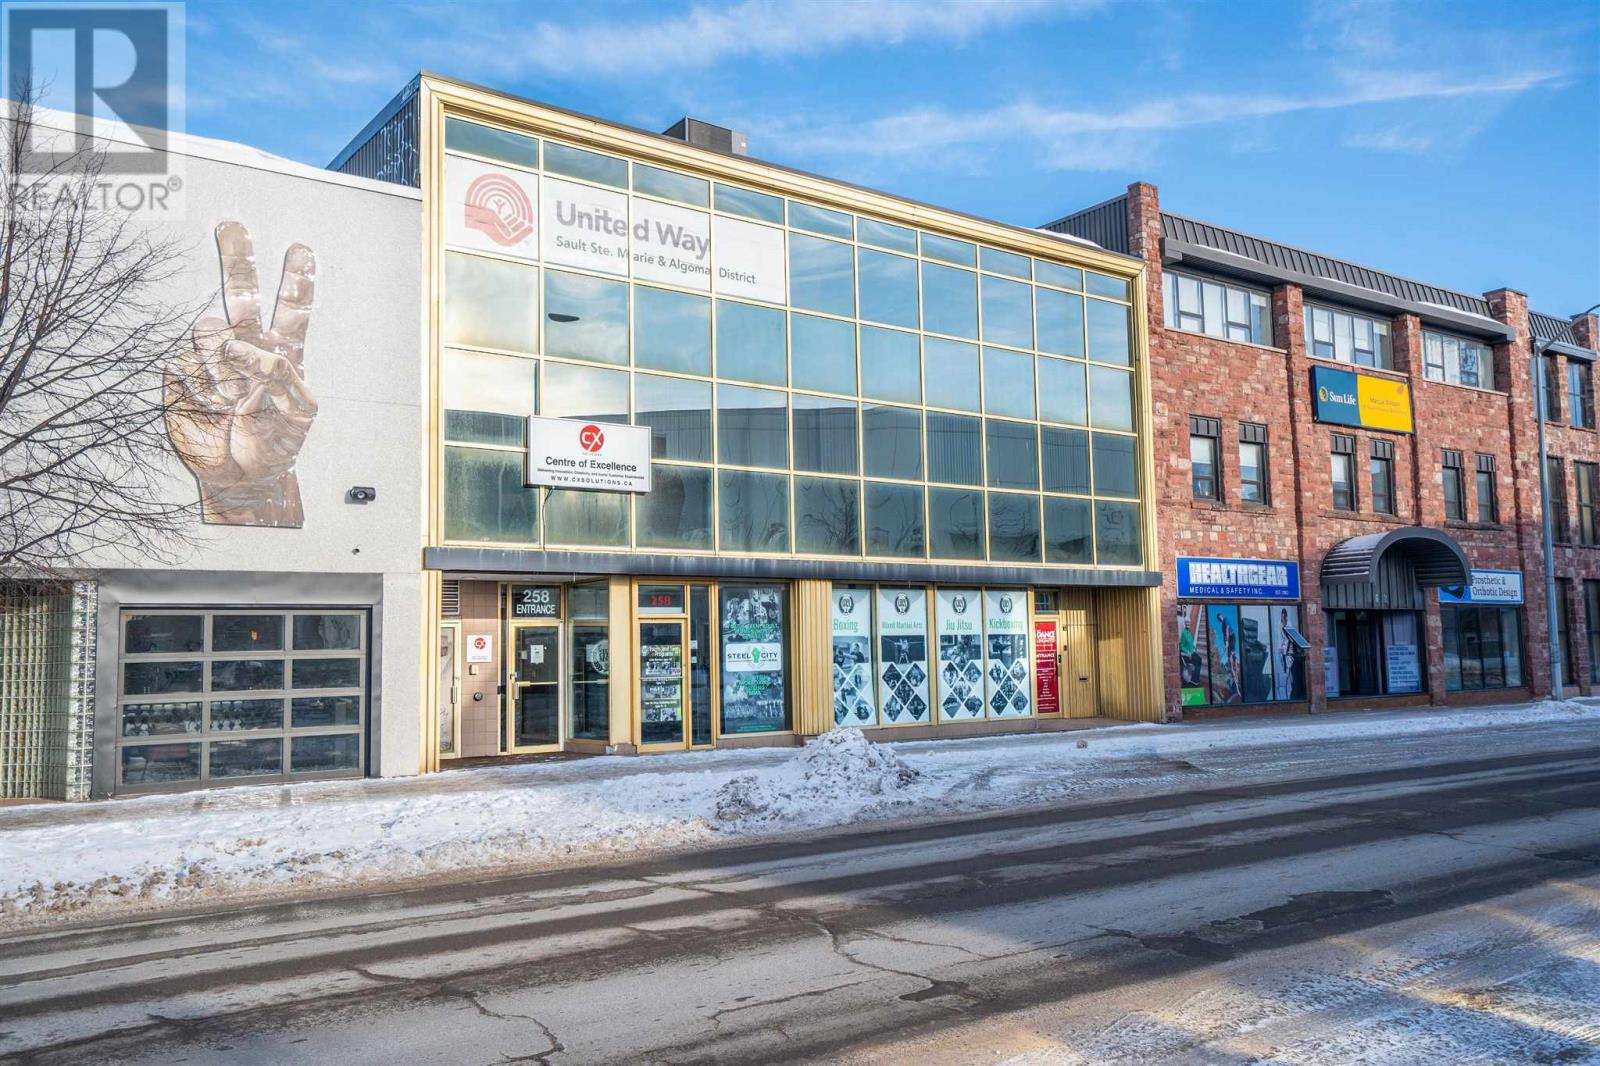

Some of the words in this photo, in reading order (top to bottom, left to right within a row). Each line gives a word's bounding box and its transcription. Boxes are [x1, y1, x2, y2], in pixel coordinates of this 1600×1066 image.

[556, 200, 649, 242] United
[655, 220, 711, 260] Way
[556, 235, 587, 252] Sault
[590, 243, 613, 257] Ste.
[617, 248, 654, 265] Marie
[657, 255, 666, 267] &
[669, 257, 711, 275] Algoma
[719, 267, 756, 284] District
[1329, 391, 1344, 404] Sun
[1344, 393, 1357, 405] Life
[545, 456, 576, 467] Centre
[578, 459, 588, 468] of
[590, 460, 637, 472] Excellence
[1189, 561, 1288, 587] HEALTHGEAR
[522, 590, 550, 603] 258
[1189, 586, 1219, 594] MEDICAL
[1226, 586, 1250, 594] SAFETY
[1472, 586, 1498, 597] Orthotic
[1499, 587, 1518, 599] Design
[516, 604, 556, 615] ENTRANCE
[833, 618, 858, 632] Boxing
[946, 617, 955, 631] Jiu
[957, 617, 973, 631] Jitsu
